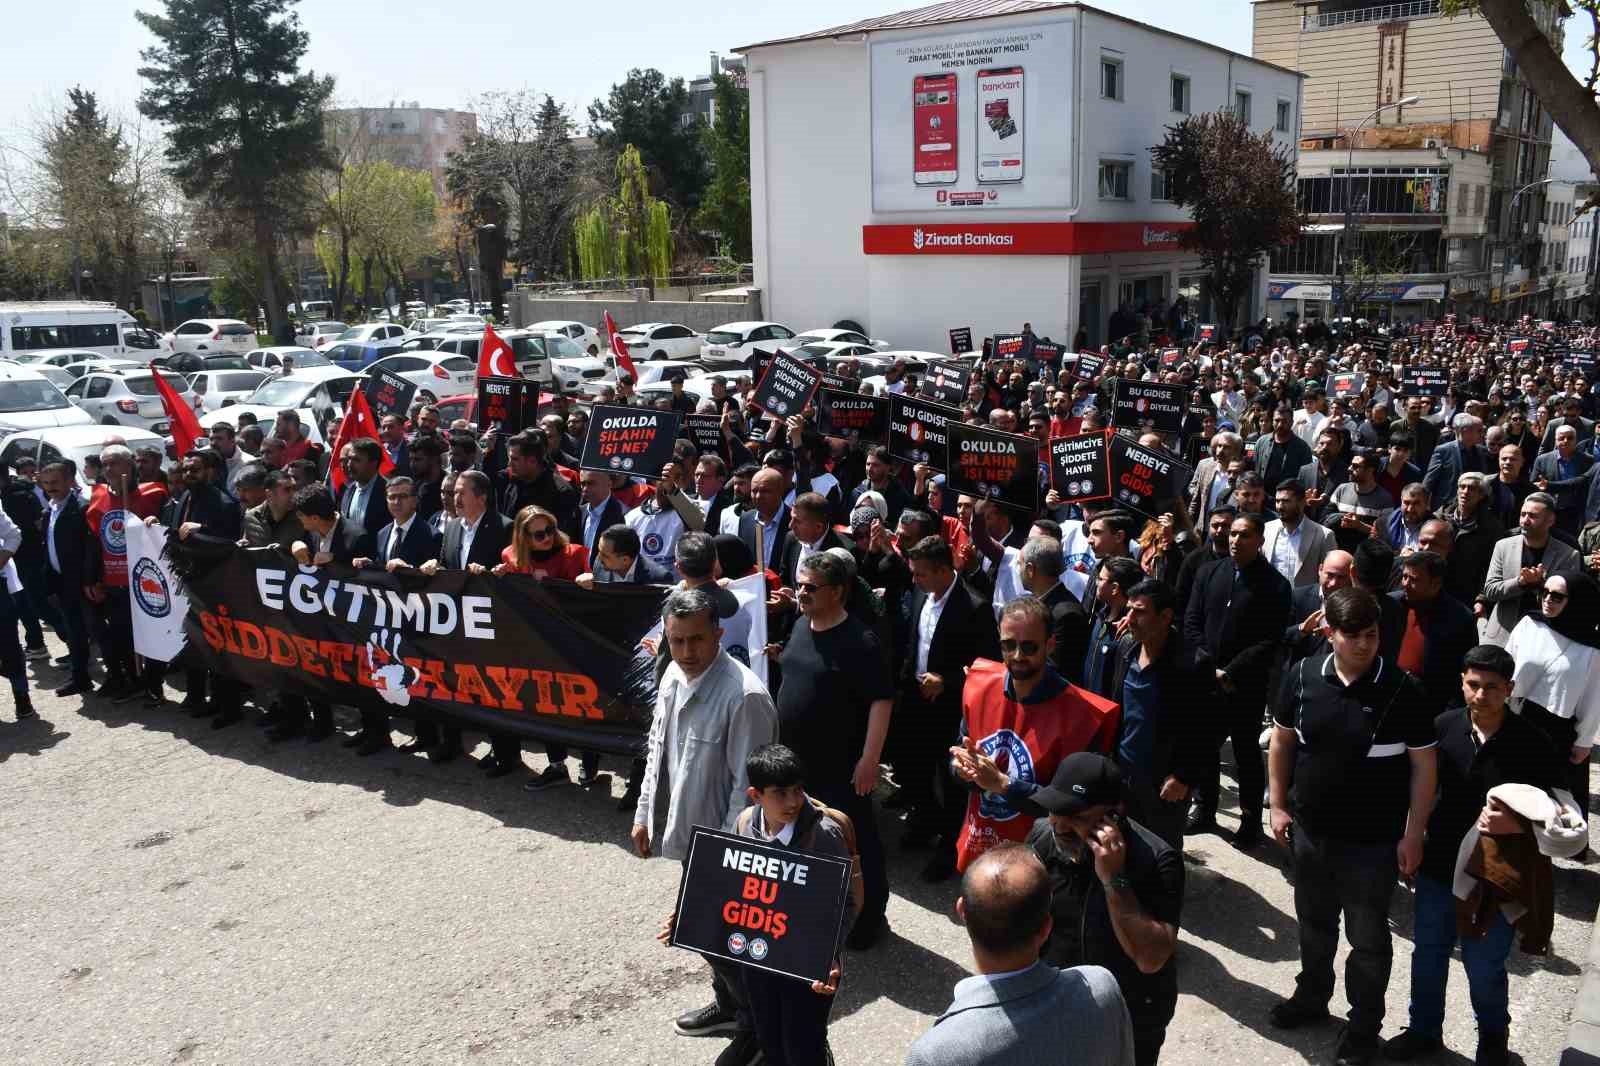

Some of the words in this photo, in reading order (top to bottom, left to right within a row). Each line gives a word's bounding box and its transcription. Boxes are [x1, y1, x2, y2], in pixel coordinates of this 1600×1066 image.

[966, 46, 1002, 58] BANKKART
[942, 59, 965, 68] HEMEN
[925, 232, 963, 246] Ziraat
[964, 232, 1013, 246] Bankası
[775, 356, 817, 385] EĞİTİMCİYE
[774, 370, 805, 392] ŞİDDETE
[486, 383, 510, 395] NEREYE
[773, 381, 796, 400] HAYIR
[1128, 387, 1142, 396] BU
[832, 401, 874, 409] OKULDA
[1118, 400, 1134, 408] DUR
[902, 406, 916, 418] BU
[602, 415, 657, 429] OKULDA
[892, 422, 908, 435] DUR
[924, 431, 946, 444] DİYEL
[622, 441, 649, 454] NE?
[960, 440, 1016, 454] OKULDA
[1053, 437, 1103, 454] EĞİTİMCİYE
[1060, 450, 1097, 467] ŞİDDETE
[1125, 447, 1170, 475] NEREYE
[1065, 464, 1093, 476] HAYIR
[1133, 464, 1153, 479] BU
[255, 563, 495, 640] EĞİTİMDE
[404, 657, 604, 720] HAYIR
[722, 847, 809, 886] NEREYE
[742, 876, 779, 905] BU
